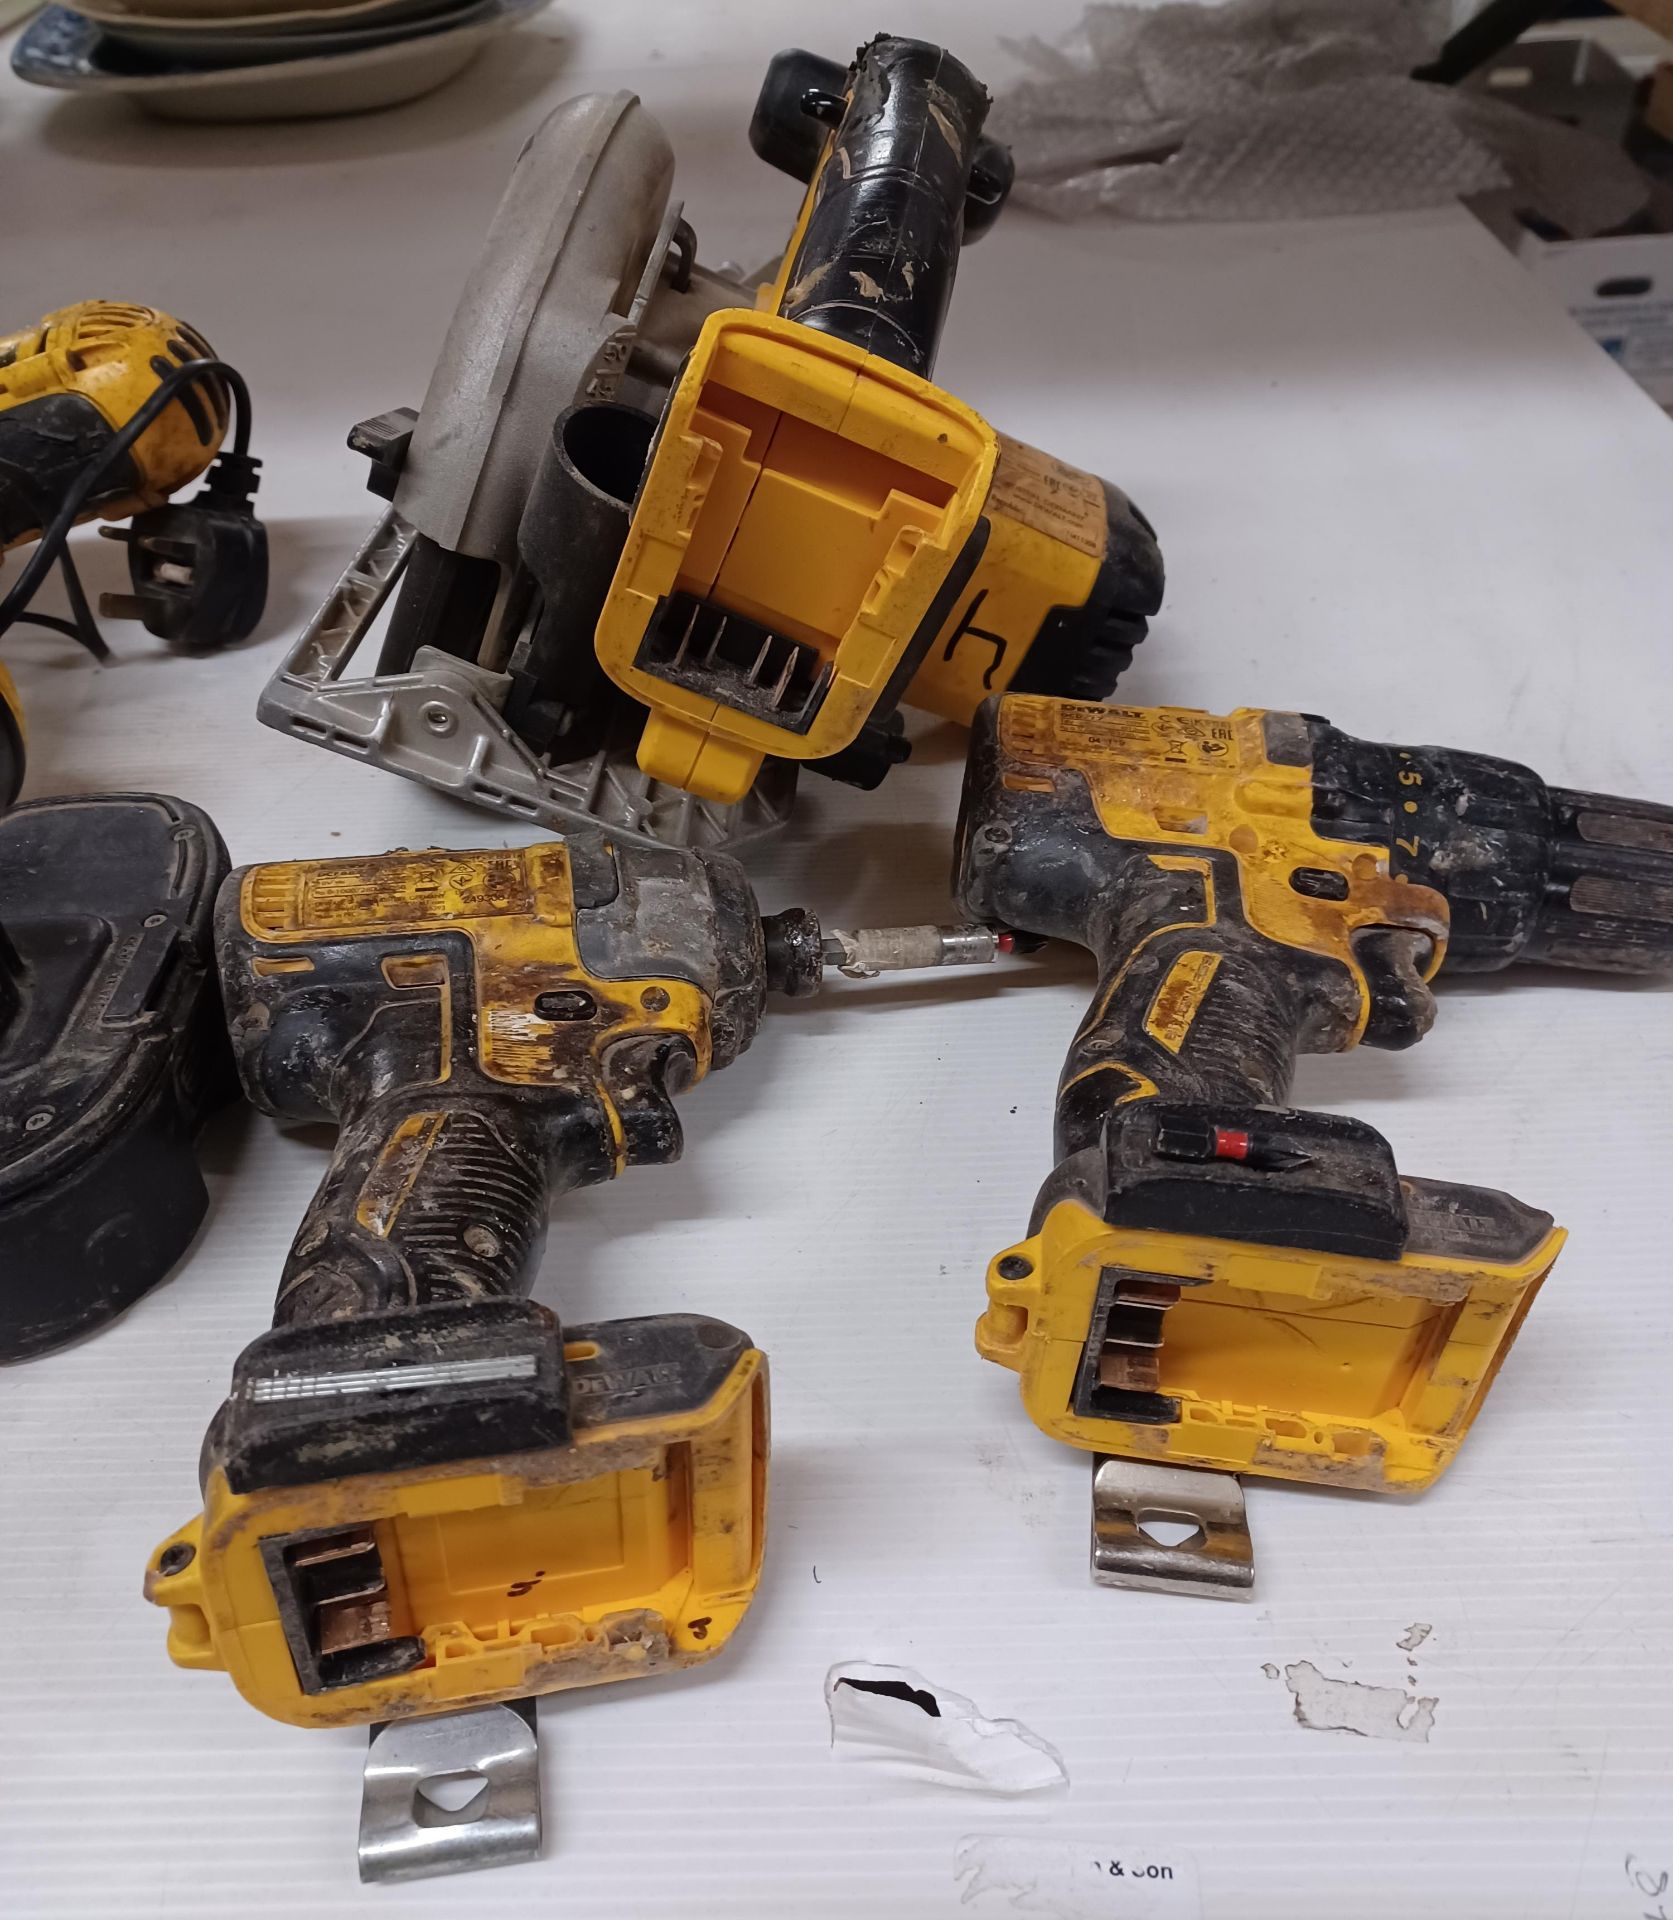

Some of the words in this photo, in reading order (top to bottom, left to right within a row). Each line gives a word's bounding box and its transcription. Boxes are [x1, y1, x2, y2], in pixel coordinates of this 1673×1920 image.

[1398, 769, 1424, 786] 5
[1395, 835, 1421, 857] 7
[1108, 1859, 1125, 1877] &
